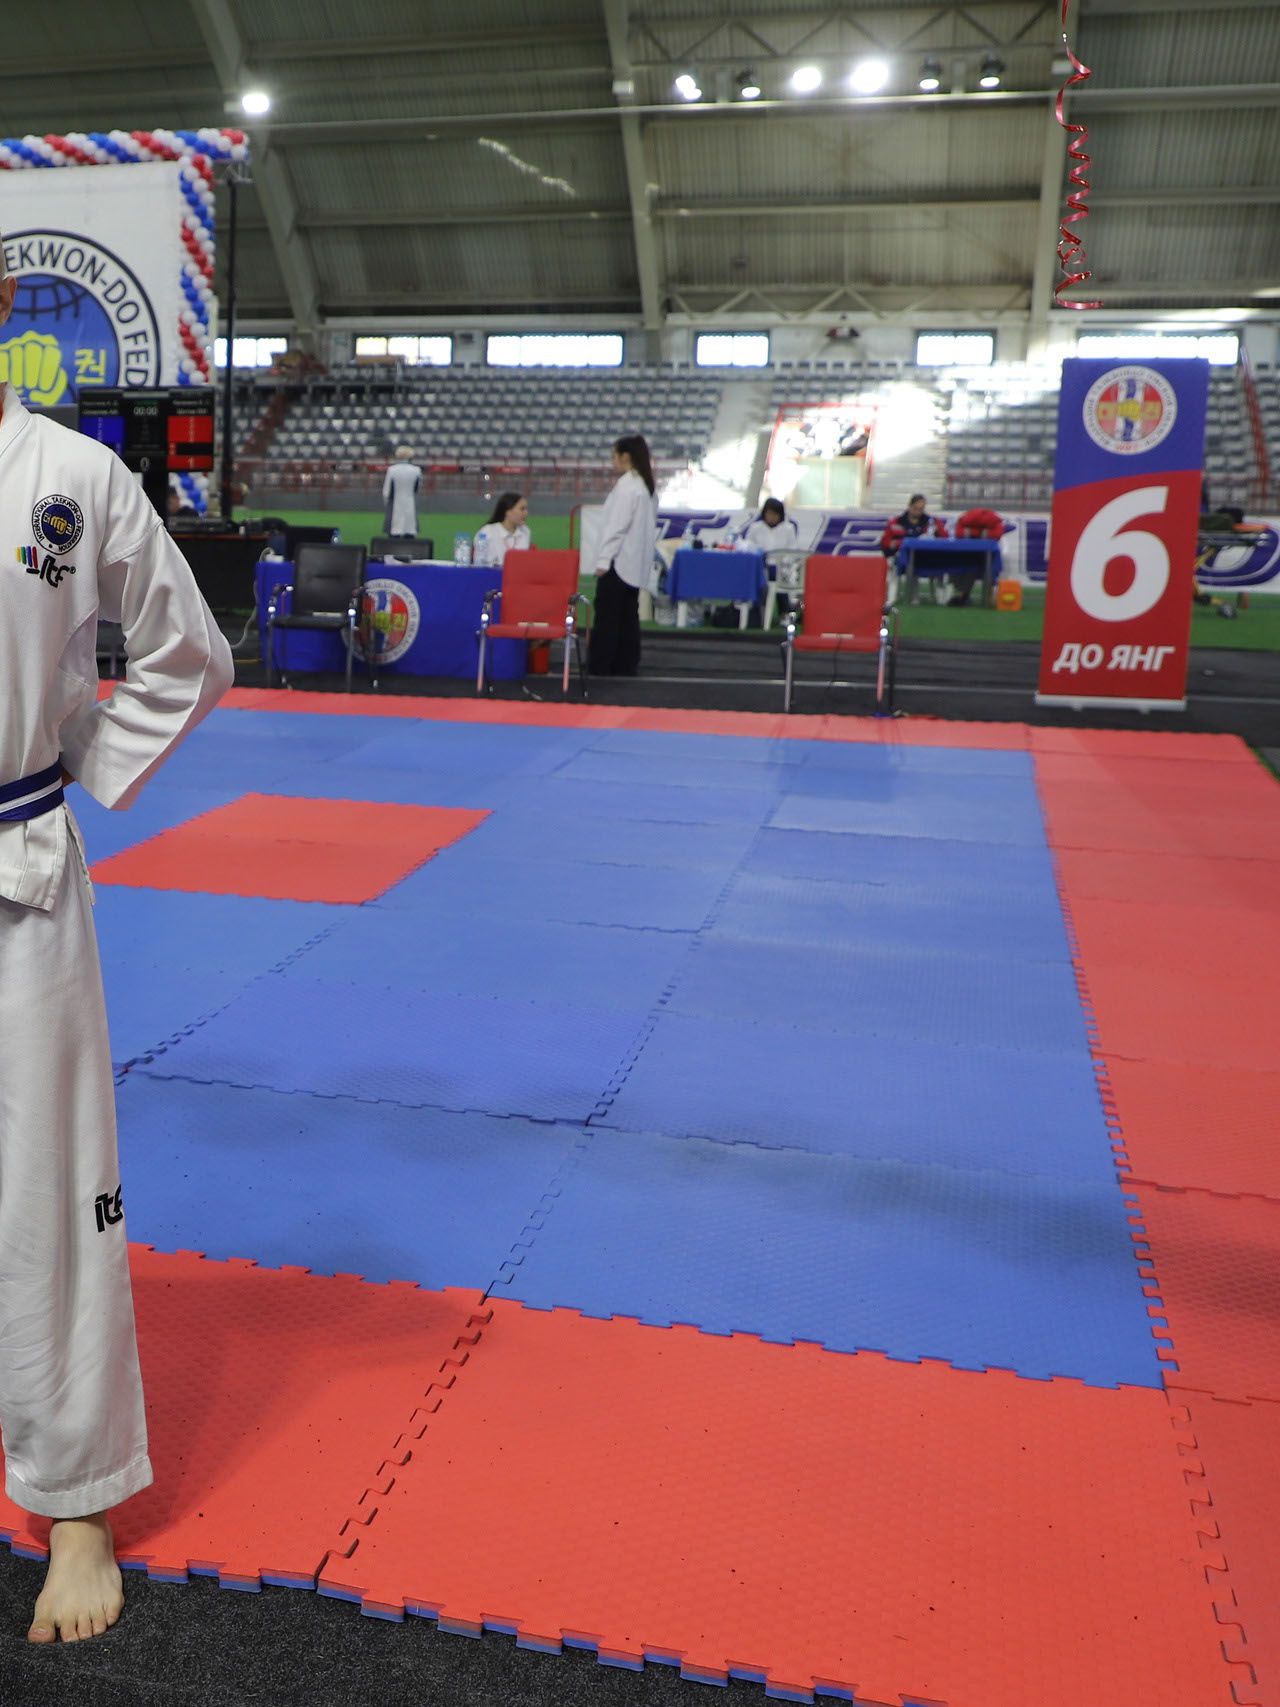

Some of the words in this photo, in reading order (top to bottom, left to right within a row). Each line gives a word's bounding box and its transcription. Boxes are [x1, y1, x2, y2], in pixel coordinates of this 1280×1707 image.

[33, 500, 52, 541] INTERNATIONAL
[51, 497, 81, 524] TAEKWON-DO
[58, 526, 82, 552] FEDERATION
[1070, 485, 1170, 622] 6
[1052, 643, 1104, 673] ДО
[1107, 645, 1176, 672] ЯНГ
